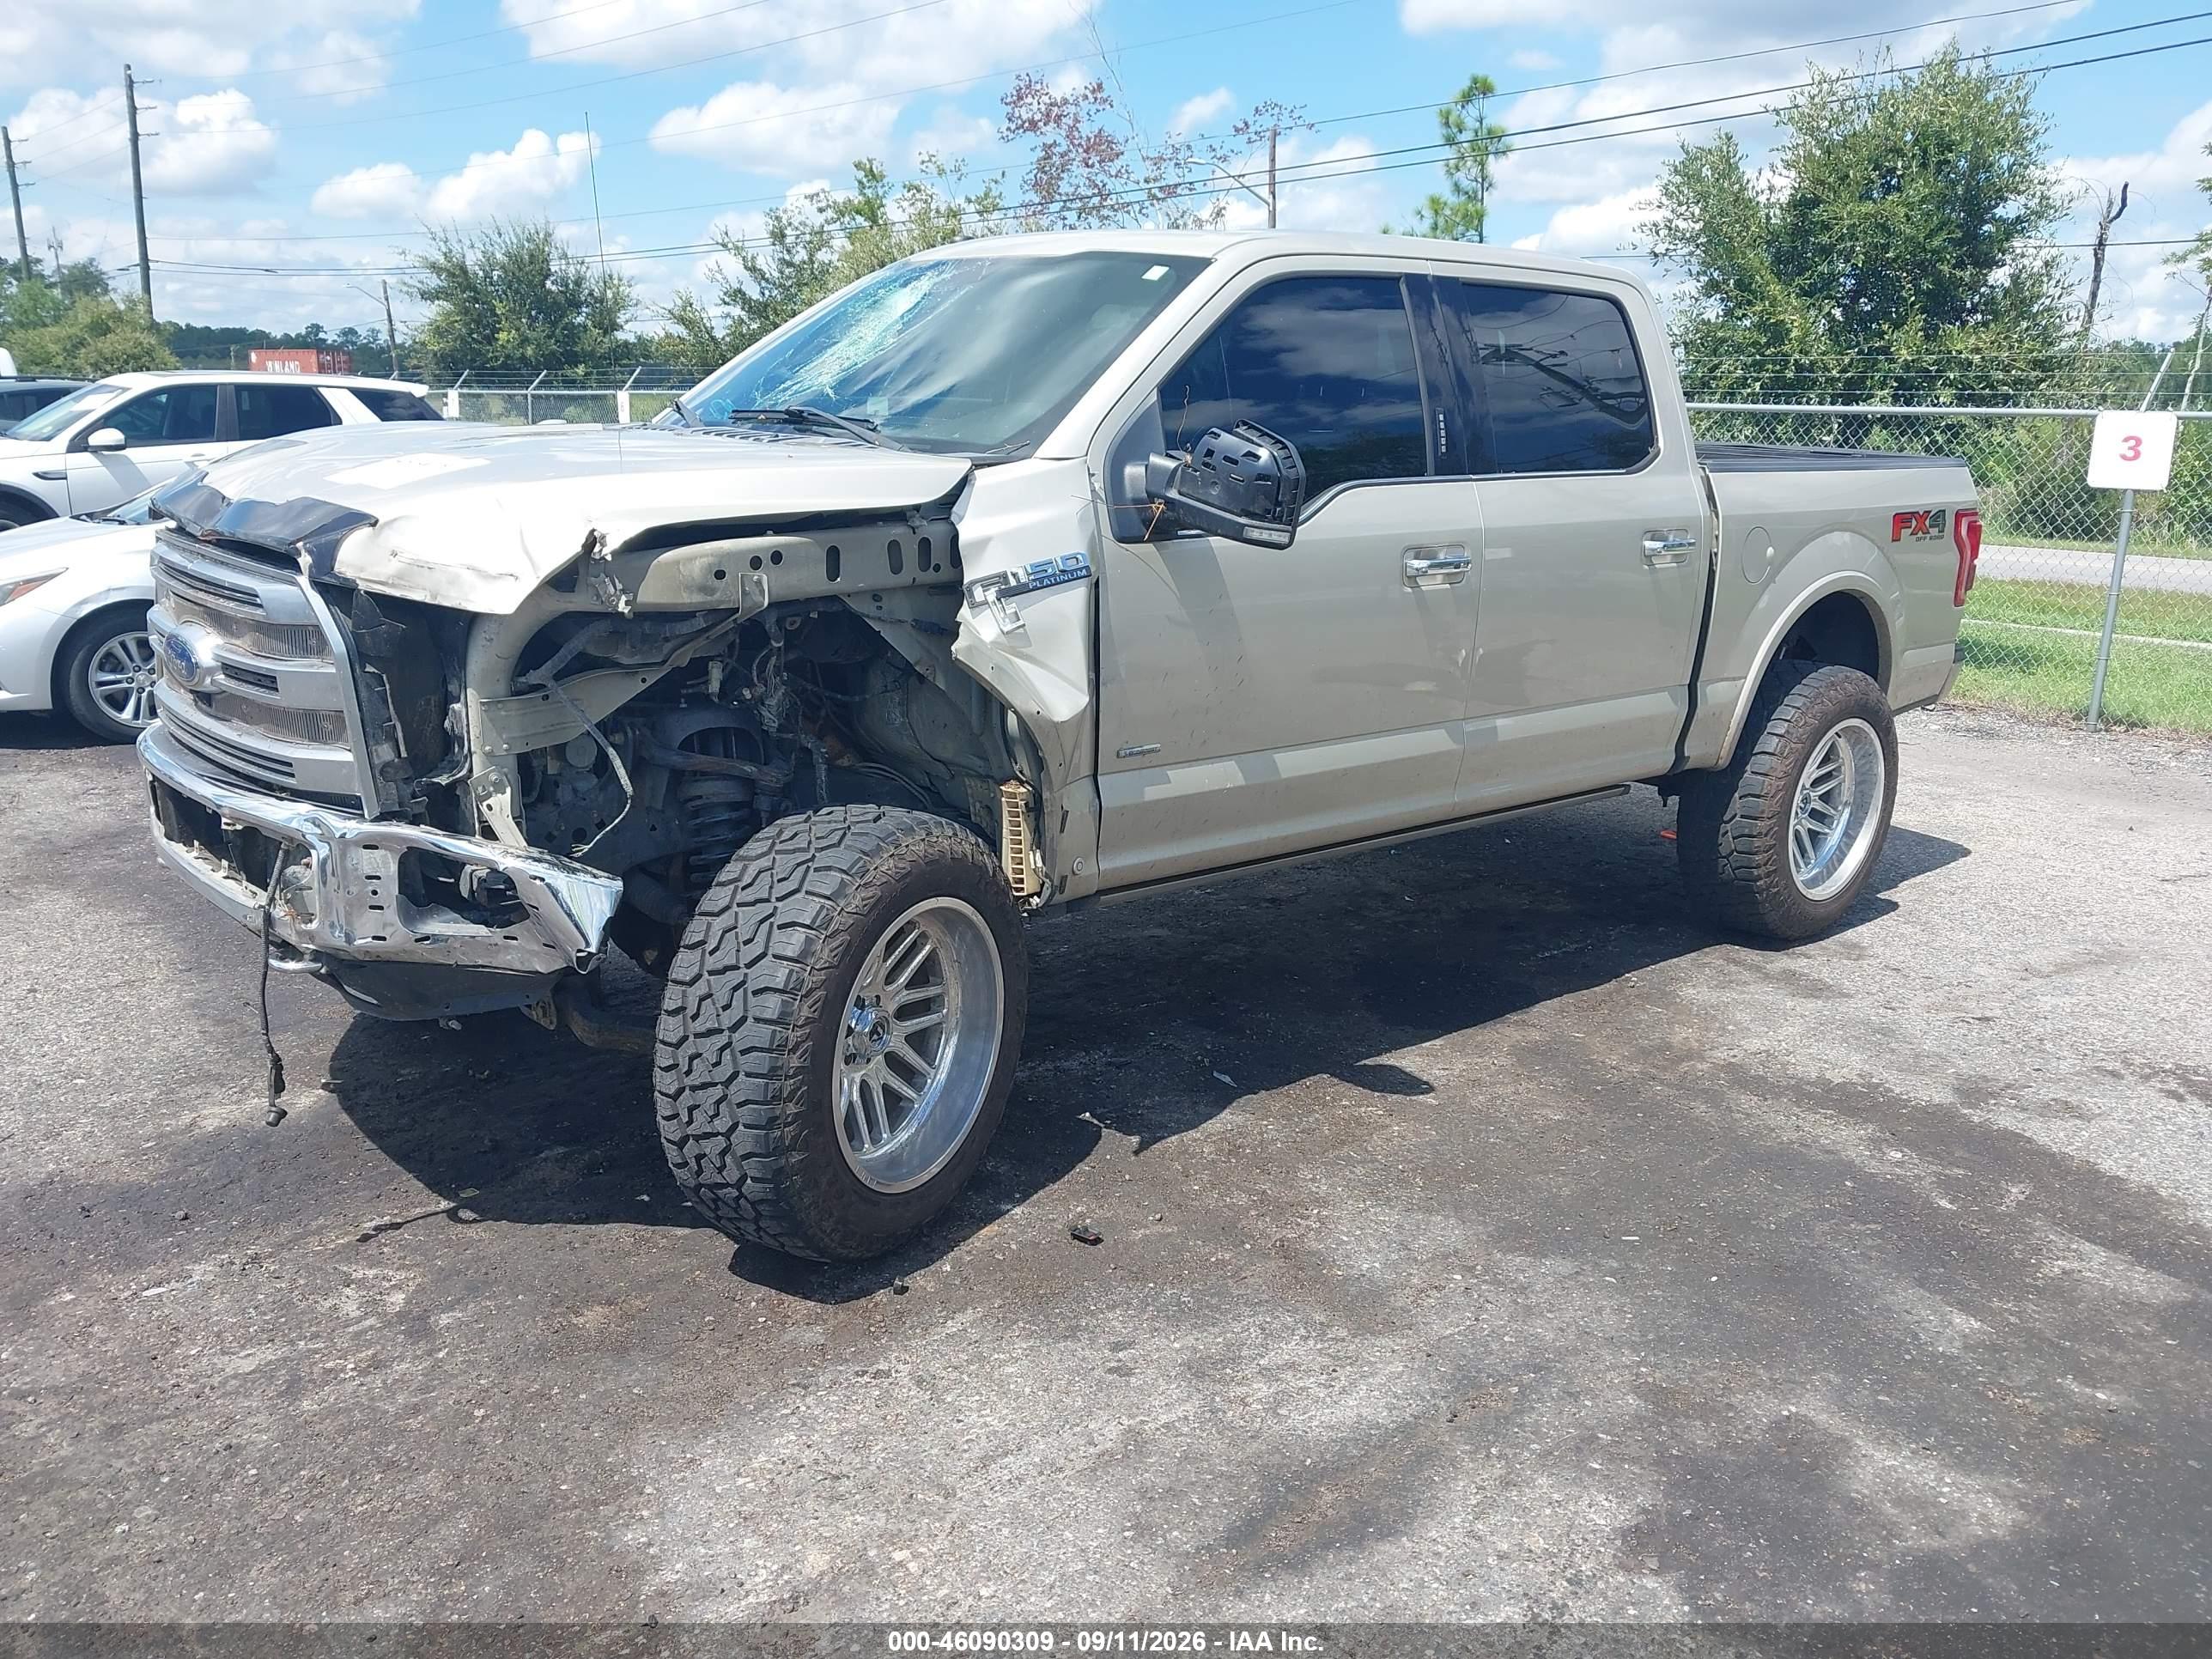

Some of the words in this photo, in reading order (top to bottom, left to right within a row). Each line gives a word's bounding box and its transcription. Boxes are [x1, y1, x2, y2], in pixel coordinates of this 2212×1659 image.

[2118, 435, 2143, 462] 3
[1891, 508, 1947, 543] FX4
[1028, 568, 1088, 590] PLATINUM
